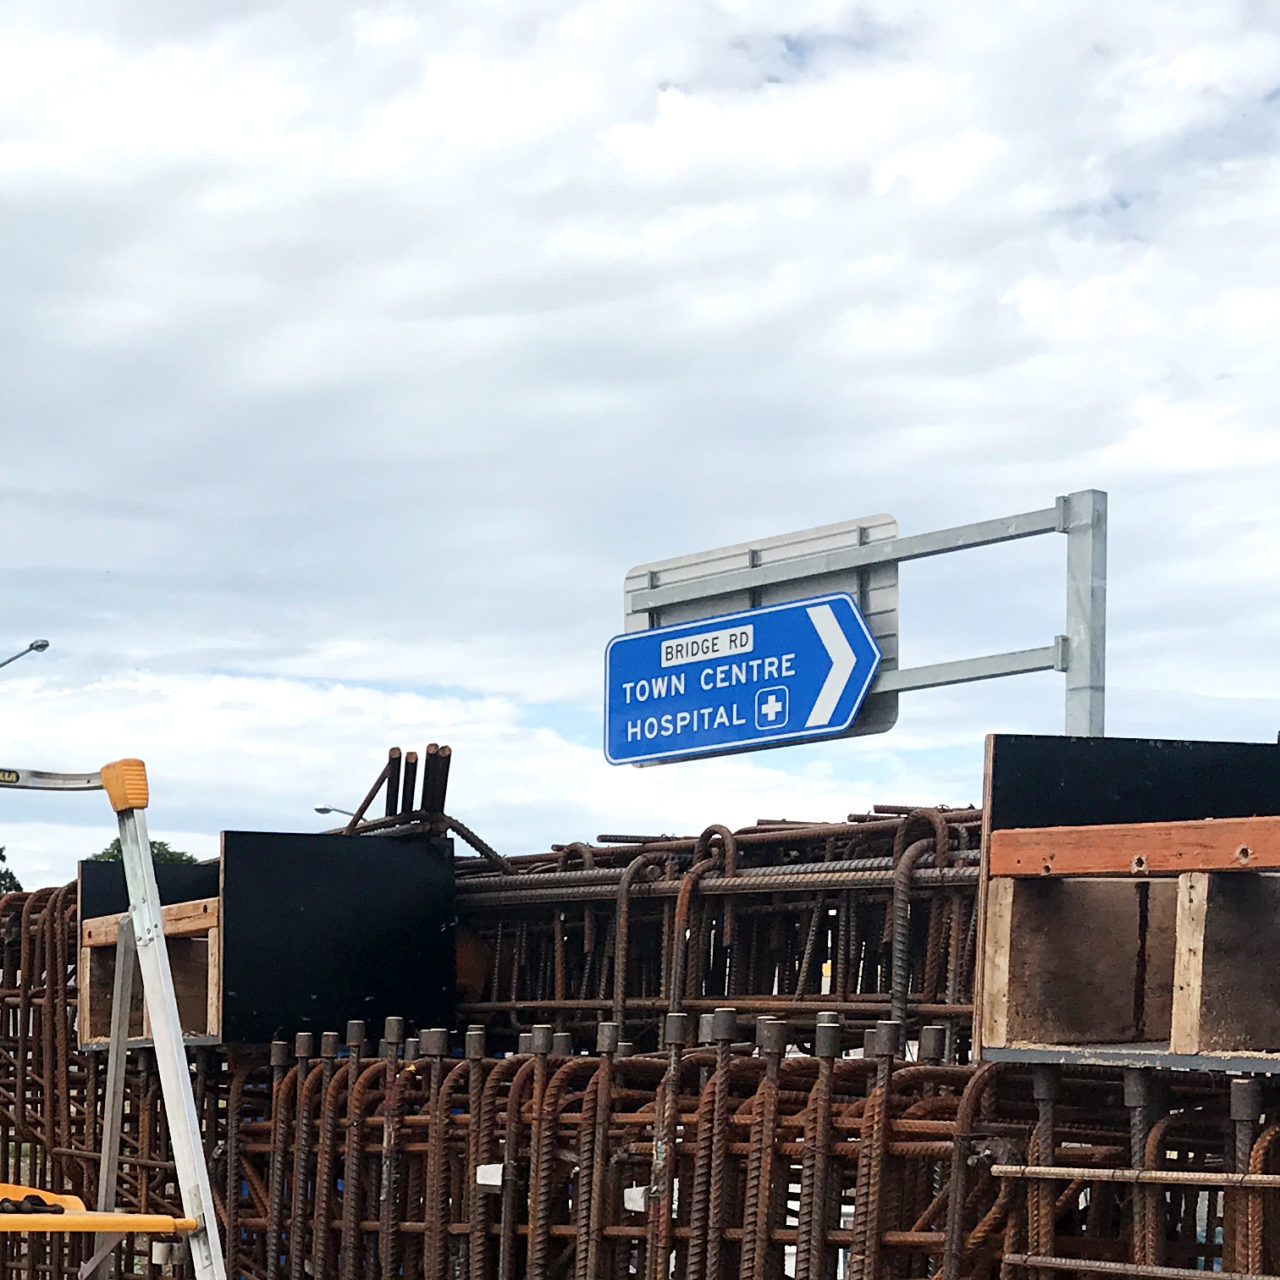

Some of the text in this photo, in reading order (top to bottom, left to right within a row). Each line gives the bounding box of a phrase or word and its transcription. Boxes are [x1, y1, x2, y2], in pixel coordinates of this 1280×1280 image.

[665, 631, 749, 661] BRIDGE RD
[622, 653, 796, 704] TOWN CENTRE
[627, 703, 746, 742] HOSPITAL
